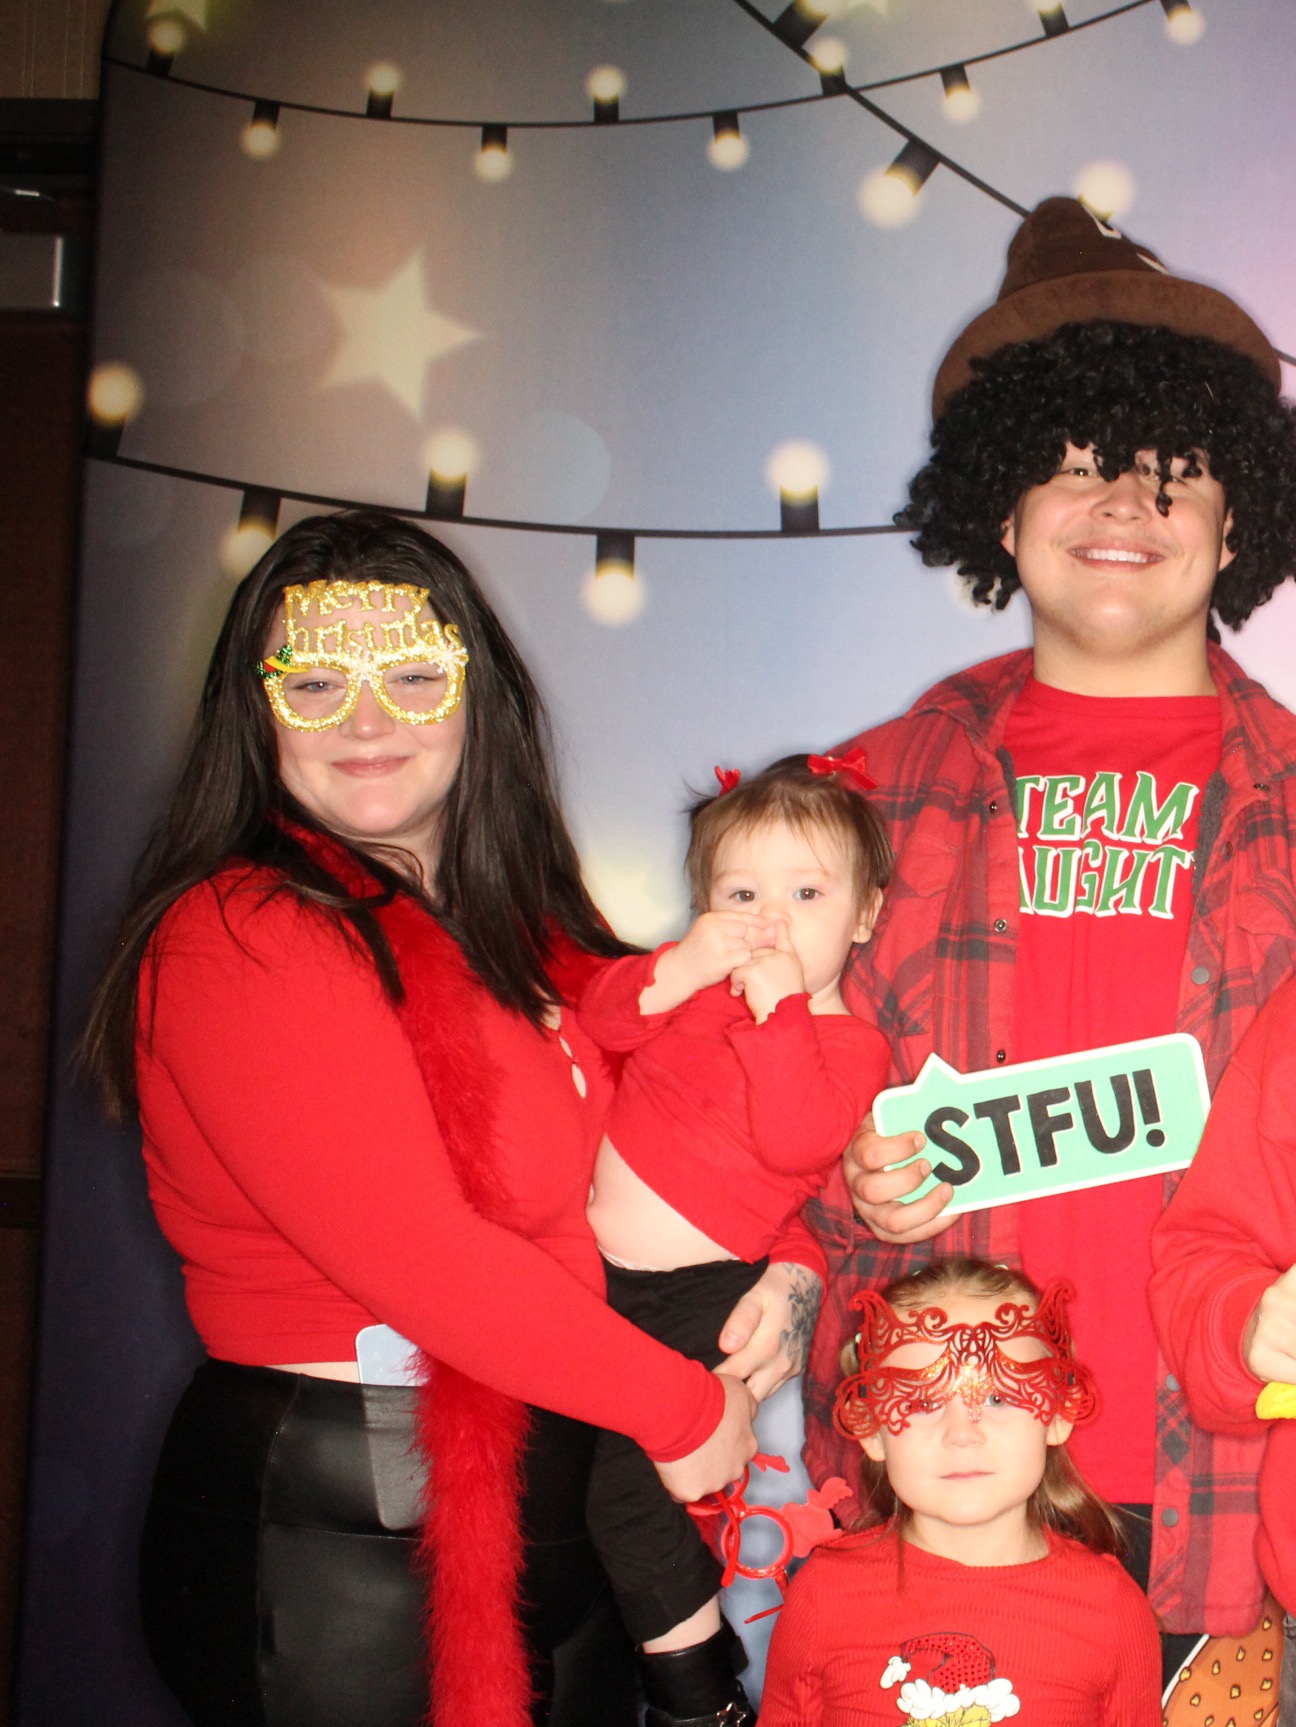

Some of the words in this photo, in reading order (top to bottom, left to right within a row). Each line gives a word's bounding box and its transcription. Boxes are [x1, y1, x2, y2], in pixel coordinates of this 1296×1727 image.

[284, 579, 431, 617] Merry
[1016, 771, 1200, 845] TEAM
[924, 1068, 1166, 1186] STFU!
